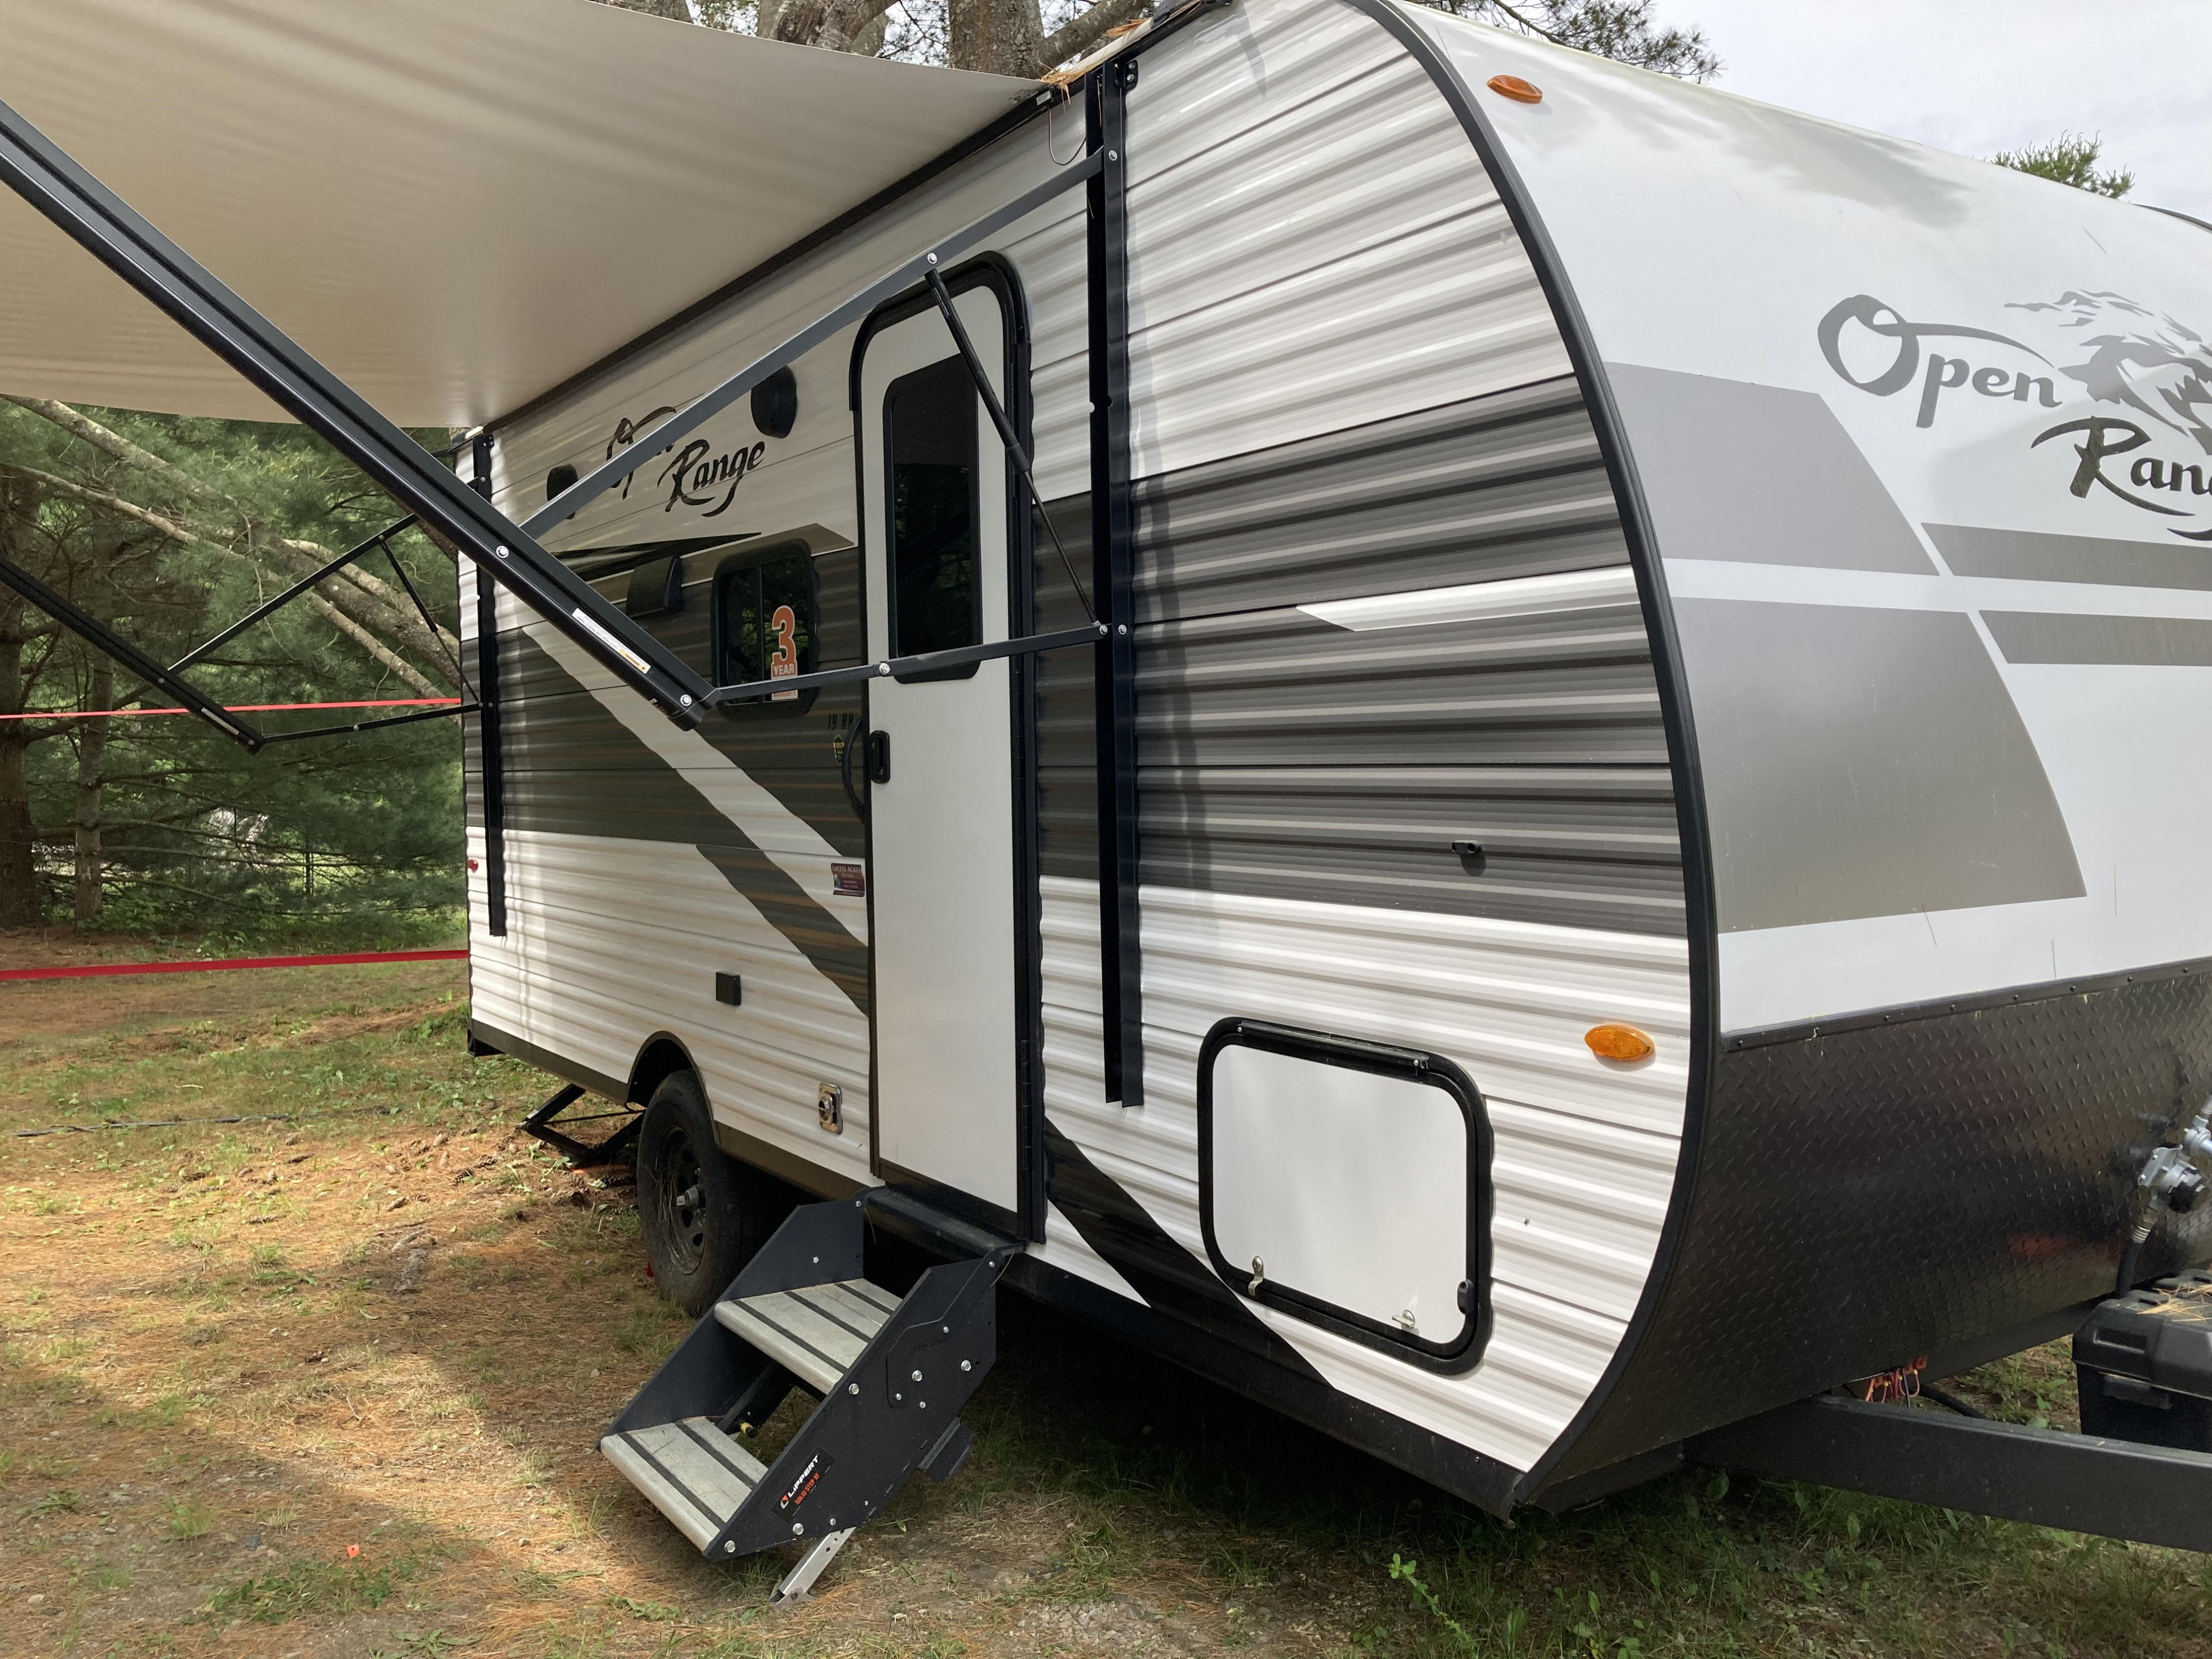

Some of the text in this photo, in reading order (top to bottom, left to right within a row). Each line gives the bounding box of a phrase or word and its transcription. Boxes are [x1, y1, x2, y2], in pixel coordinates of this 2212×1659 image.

[1817, 294, 2063, 429] Open
[657, 439, 765, 517] Range
[2031, 415, 2212, 541] Ran
[773, 606, 796, 665] 3
[773, 664, 795, 676] YEAR
[795, 1490, 807, 1504] SOLID
[805, 1479, 815, 1491] STEP
